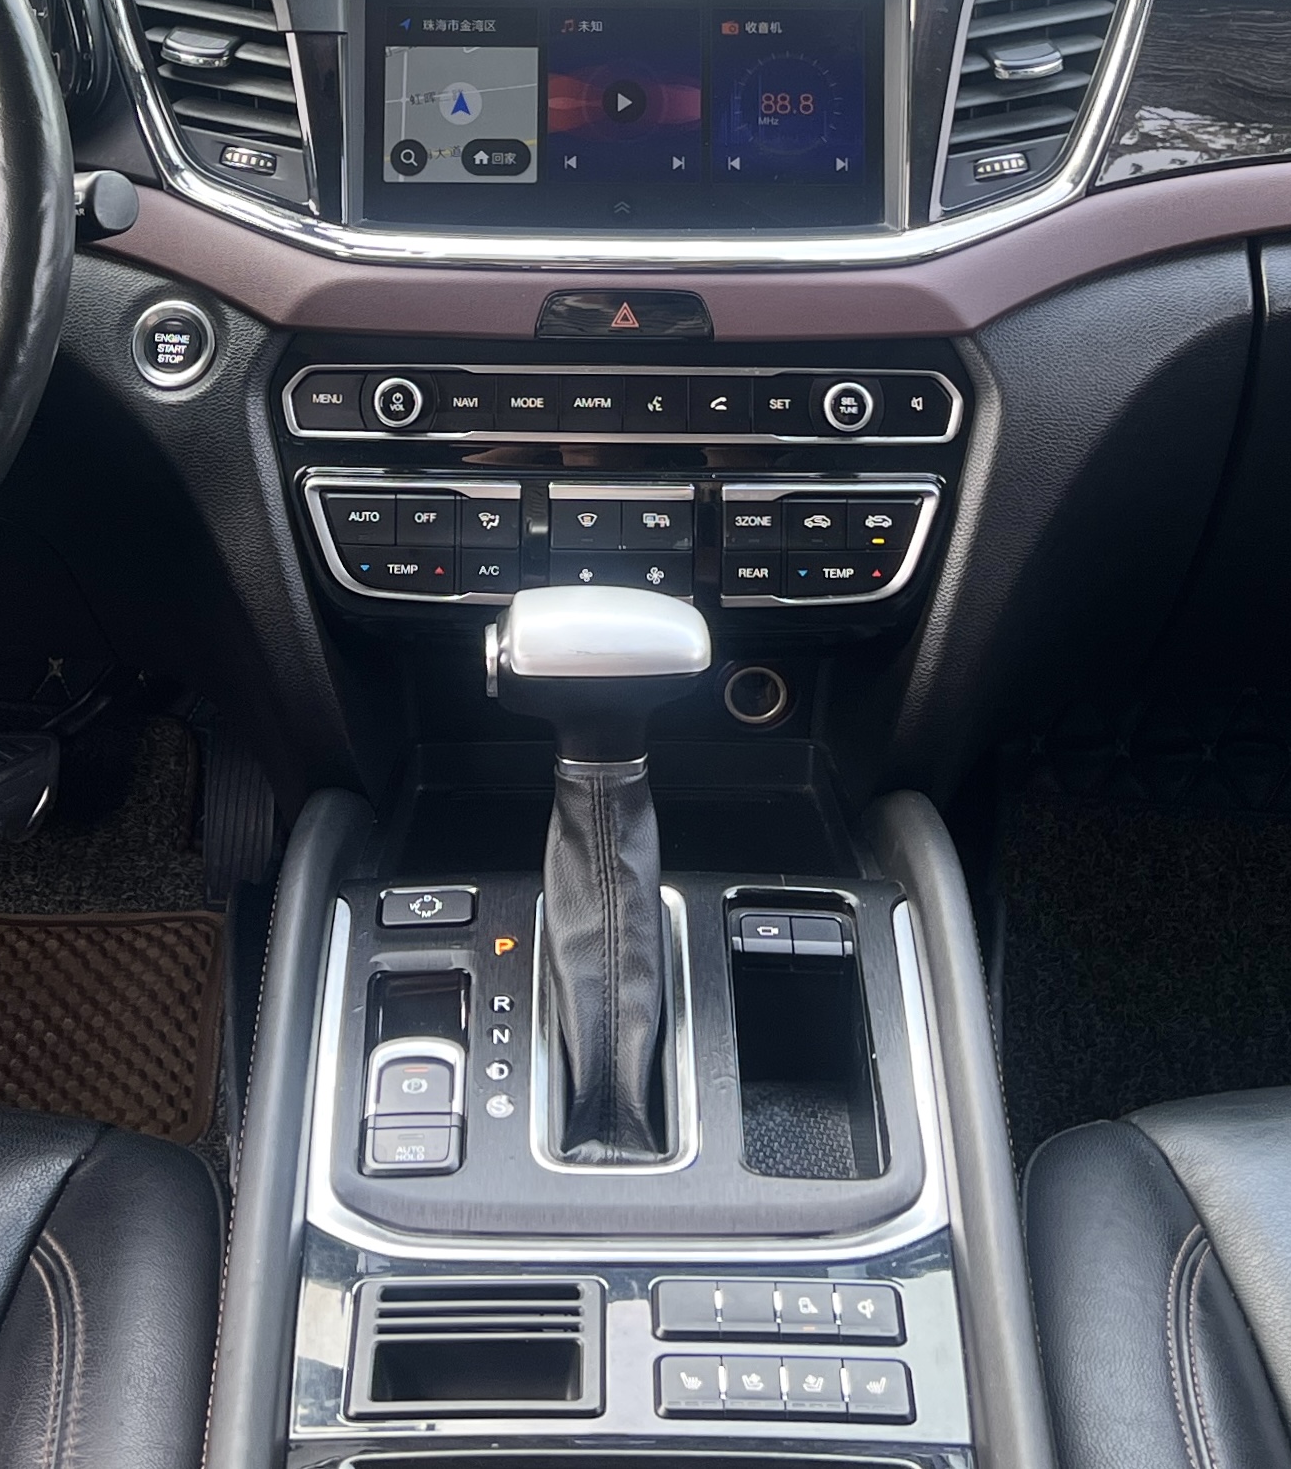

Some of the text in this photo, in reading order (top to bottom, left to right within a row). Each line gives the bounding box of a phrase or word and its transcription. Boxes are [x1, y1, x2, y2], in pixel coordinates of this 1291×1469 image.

[422, 19, 497, 32] 珠海市金湾区
[578, 20, 603, 33] 未知
[745, 21, 783, 34] 收音机
[761, 93, 814, 115] 88.8
[758, 117, 779, 126] MHz
[491, 153, 517, 165] 回家
[154, 332, 190, 344] ENGINE
[156, 343, 188, 354] START
[156, 353, 184, 364] STOP
[312, 393, 343, 405] MENU
[453, 397, 479, 409] NAVI
[510, 397, 545, 409] MODE
[573, 396, 612, 409] AM/FM
[769, 398, 792, 410] SET
[840, 396, 858, 406] SEL
[389, 404, 405, 412] VOL
[839, 406, 859, 415] TUNE
[348, 510, 380, 523] AUTO
[414, 512, 437, 523] OFF
[735, 516, 772, 527] 3ZONE
[387, 564, 419, 576] TEMP
[478, 565, 501, 577] A/C
[738, 567, 769, 579] REAR
[822, 567, 854, 579] TEMP
[494, 938, 515, 956] P
[493, 996, 511, 1012] R
[492, 1029, 510, 1045] N
[494, 1062, 510, 1080] D
[396, 1145, 425, 1154] AUTO
[395, 1153, 425, 1162] HOLD
